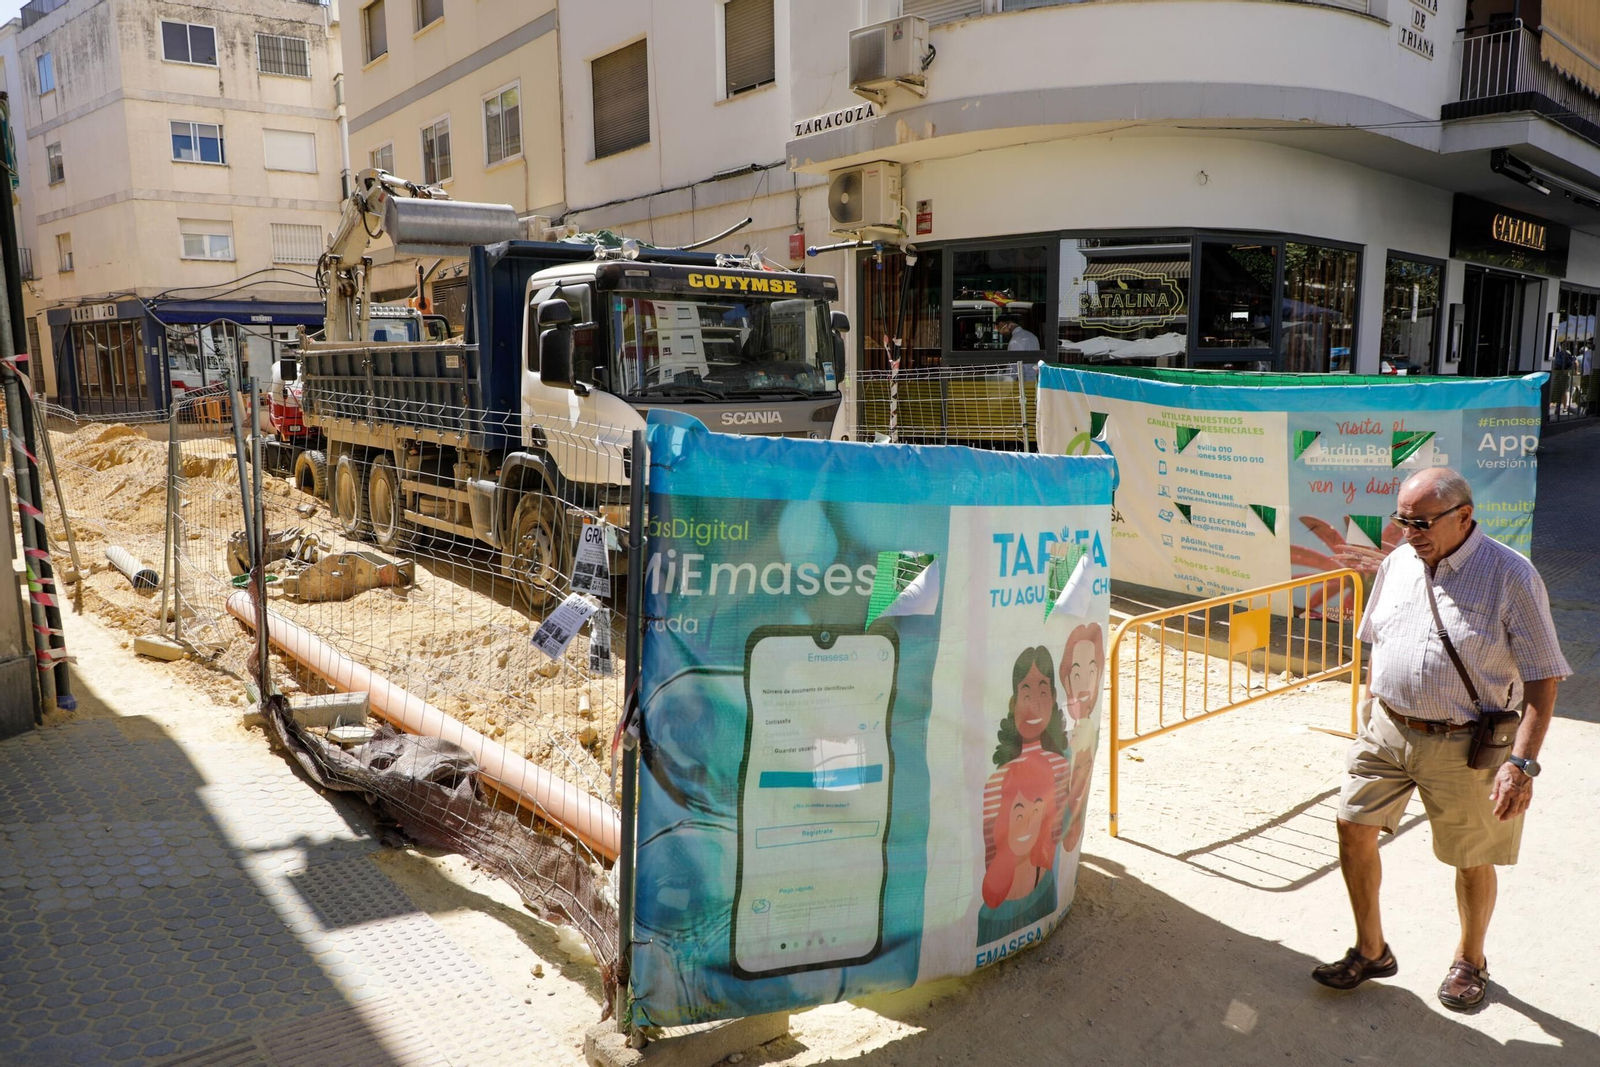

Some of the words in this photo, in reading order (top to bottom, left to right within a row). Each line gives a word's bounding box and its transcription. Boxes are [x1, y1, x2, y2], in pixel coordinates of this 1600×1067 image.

[1414, 10, 1426, 29] DE
[1401, 28, 1434, 57] TRIANA
[795, 104, 875, 137] ZARAGOZA
[688, 273, 798, 294] COTYMSE
[1078, 292, 1170, 310] CATALINA
[721, 411, 783, 426] SCANIA
[1161, 411, 1192, 423] UTILIZA
[1193, 414, 1244, 425] NUESTROS
[1336, 417, 1384, 435] visita
[1478, 417, 1541, 428] #Emases
[1196, 443, 1217, 453] evilla
[1218, 446, 1233, 454] 010
[1321, 443, 1361, 456] ardín
[1477, 432, 1539, 458] App
[1233, 456, 1248, 464] 010
[1249, 456, 1265, 464] 010
[1476, 458, 1527, 469] Versión
[1200, 470, 1232, 480] Emasesa
[1177, 486, 1206, 497] OFICINA
[1206, 491, 1235, 502] ONLINE
[1308, 480, 1333, 494] ven
[1342, 481, 1357, 505] y
[1366, 476, 1400, 495] disf
[1191, 514, 1207, 523] REO
[585, 526, 603, 545] GRA
[648, 515, 750, 546] ásDigital
[1181, 536, 1207, 547] PÁGINA
[1208, 542, 1224, 552] WEB
[645, 548, 877, 597] MiEmases
[1215, 565, 1231, 576] 365
[989, 588, 1013, 608] TU
[1014, 585, 1046, 606] AGU
[808, 652, 849, 662] Emasesa
